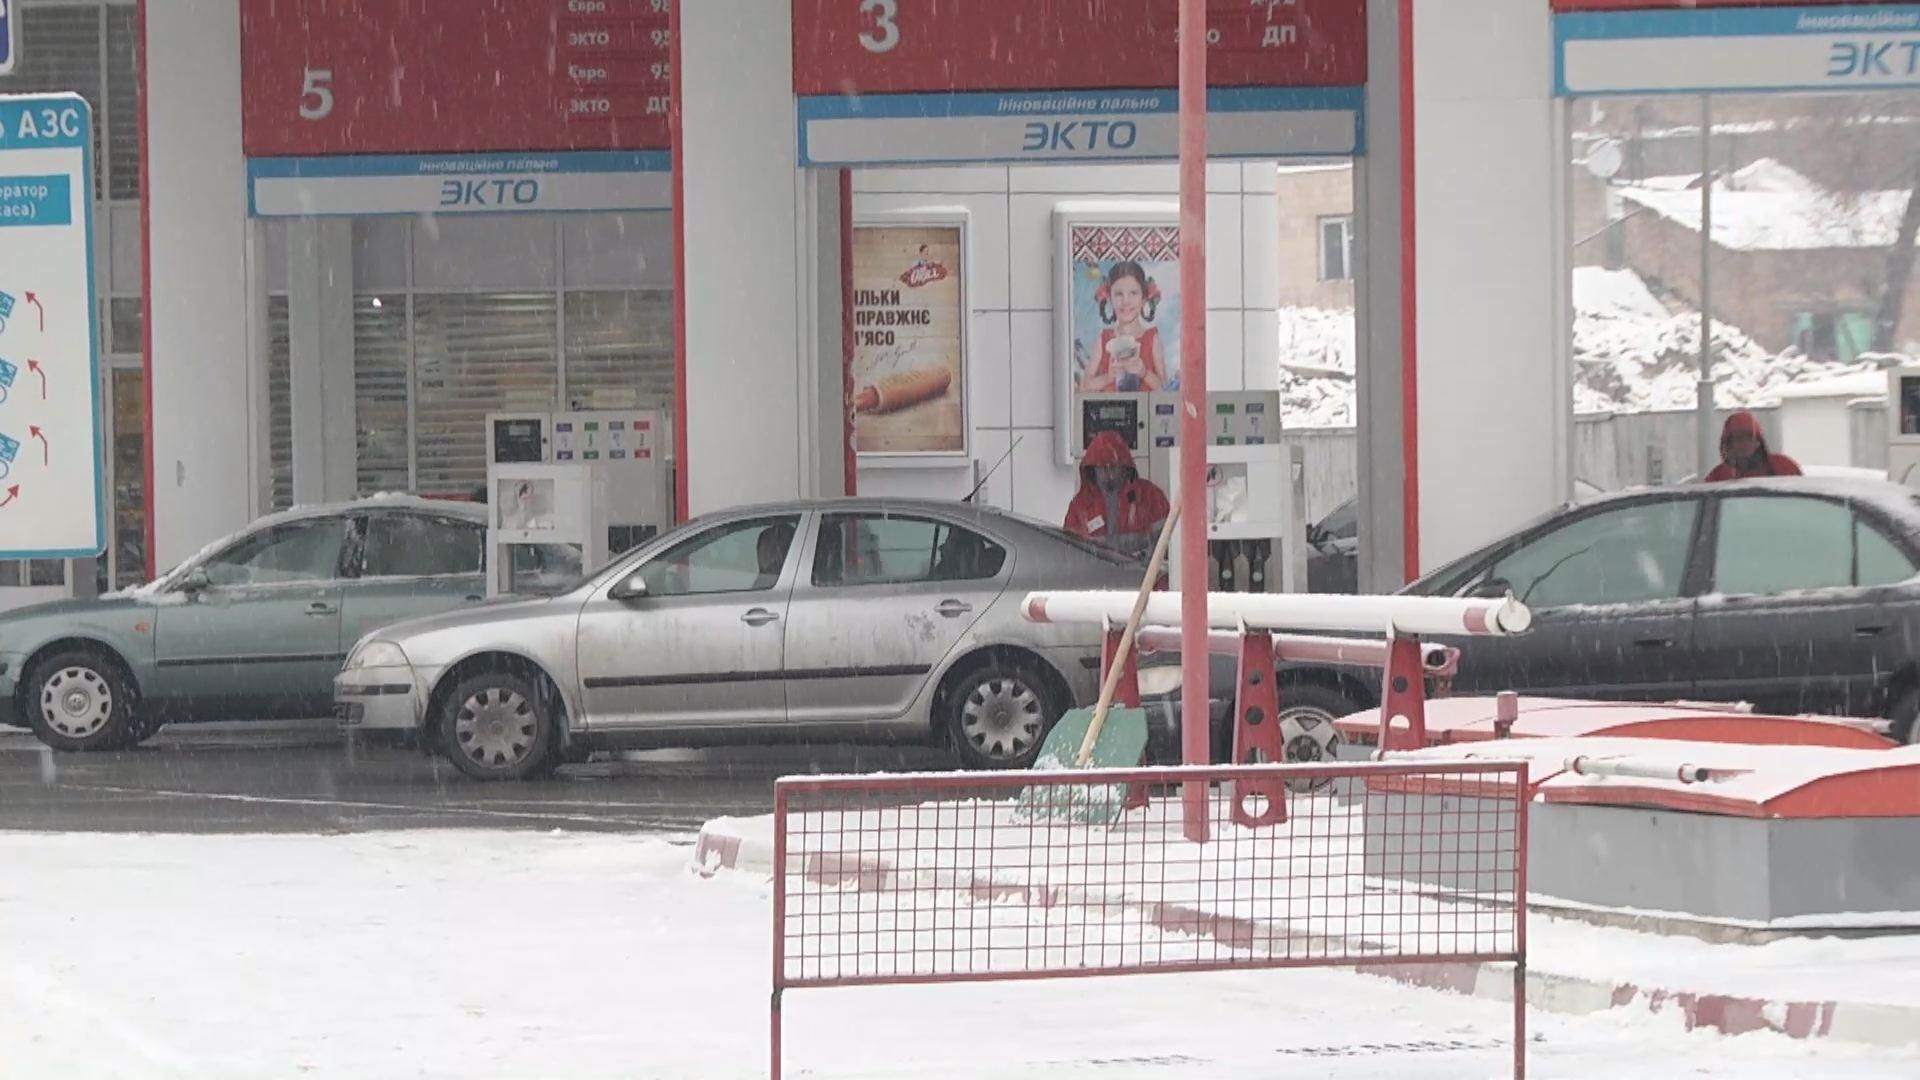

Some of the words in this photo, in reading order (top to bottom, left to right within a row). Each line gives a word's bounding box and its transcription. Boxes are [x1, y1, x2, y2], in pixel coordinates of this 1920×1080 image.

[857, 0, 900, 53] 3
[1262, 25, 1297, 47] ДП
[1826, 41, 1920, 76] ЭКТ
[299, 67, 334, 120] 5
[18, 108, 80, 139] АЗС
[1022, 120, 1137, 151] ЭКТО
[440, 178, 539, 206] ЭКТО
[0, 202, 36, 219] аса)
[854, 289, 901, 306] ІЛЬКИ
[856, 309, 931, 326] ПРАВЖНЄ
